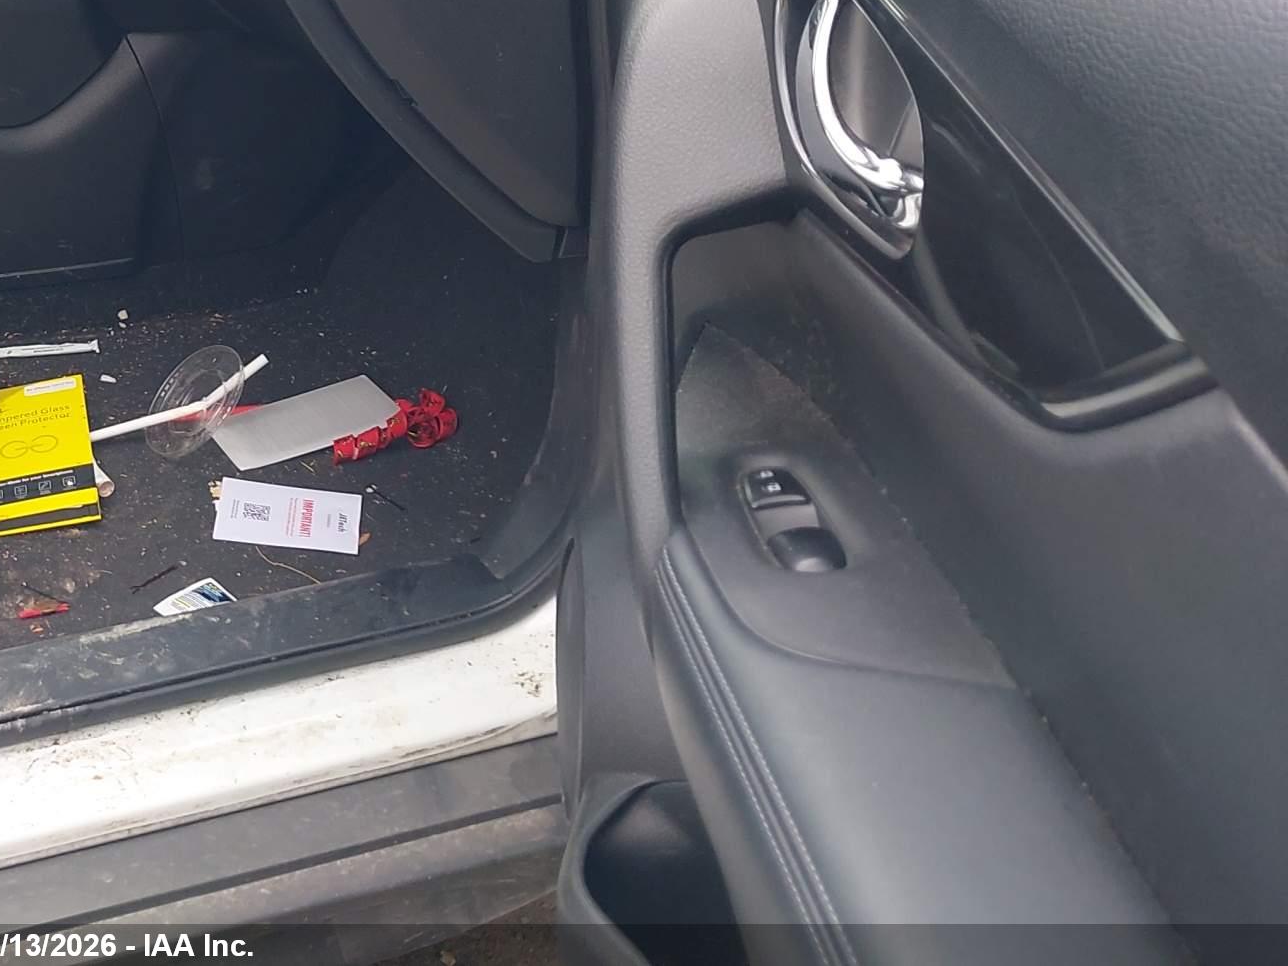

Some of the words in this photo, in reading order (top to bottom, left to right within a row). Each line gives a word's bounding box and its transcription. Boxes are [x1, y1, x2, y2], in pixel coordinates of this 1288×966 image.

[40, 405, 71, 415] Glass
[20, 412, 72, 427] Protector
[299, 498, 316, 538] IMPORTANT!
